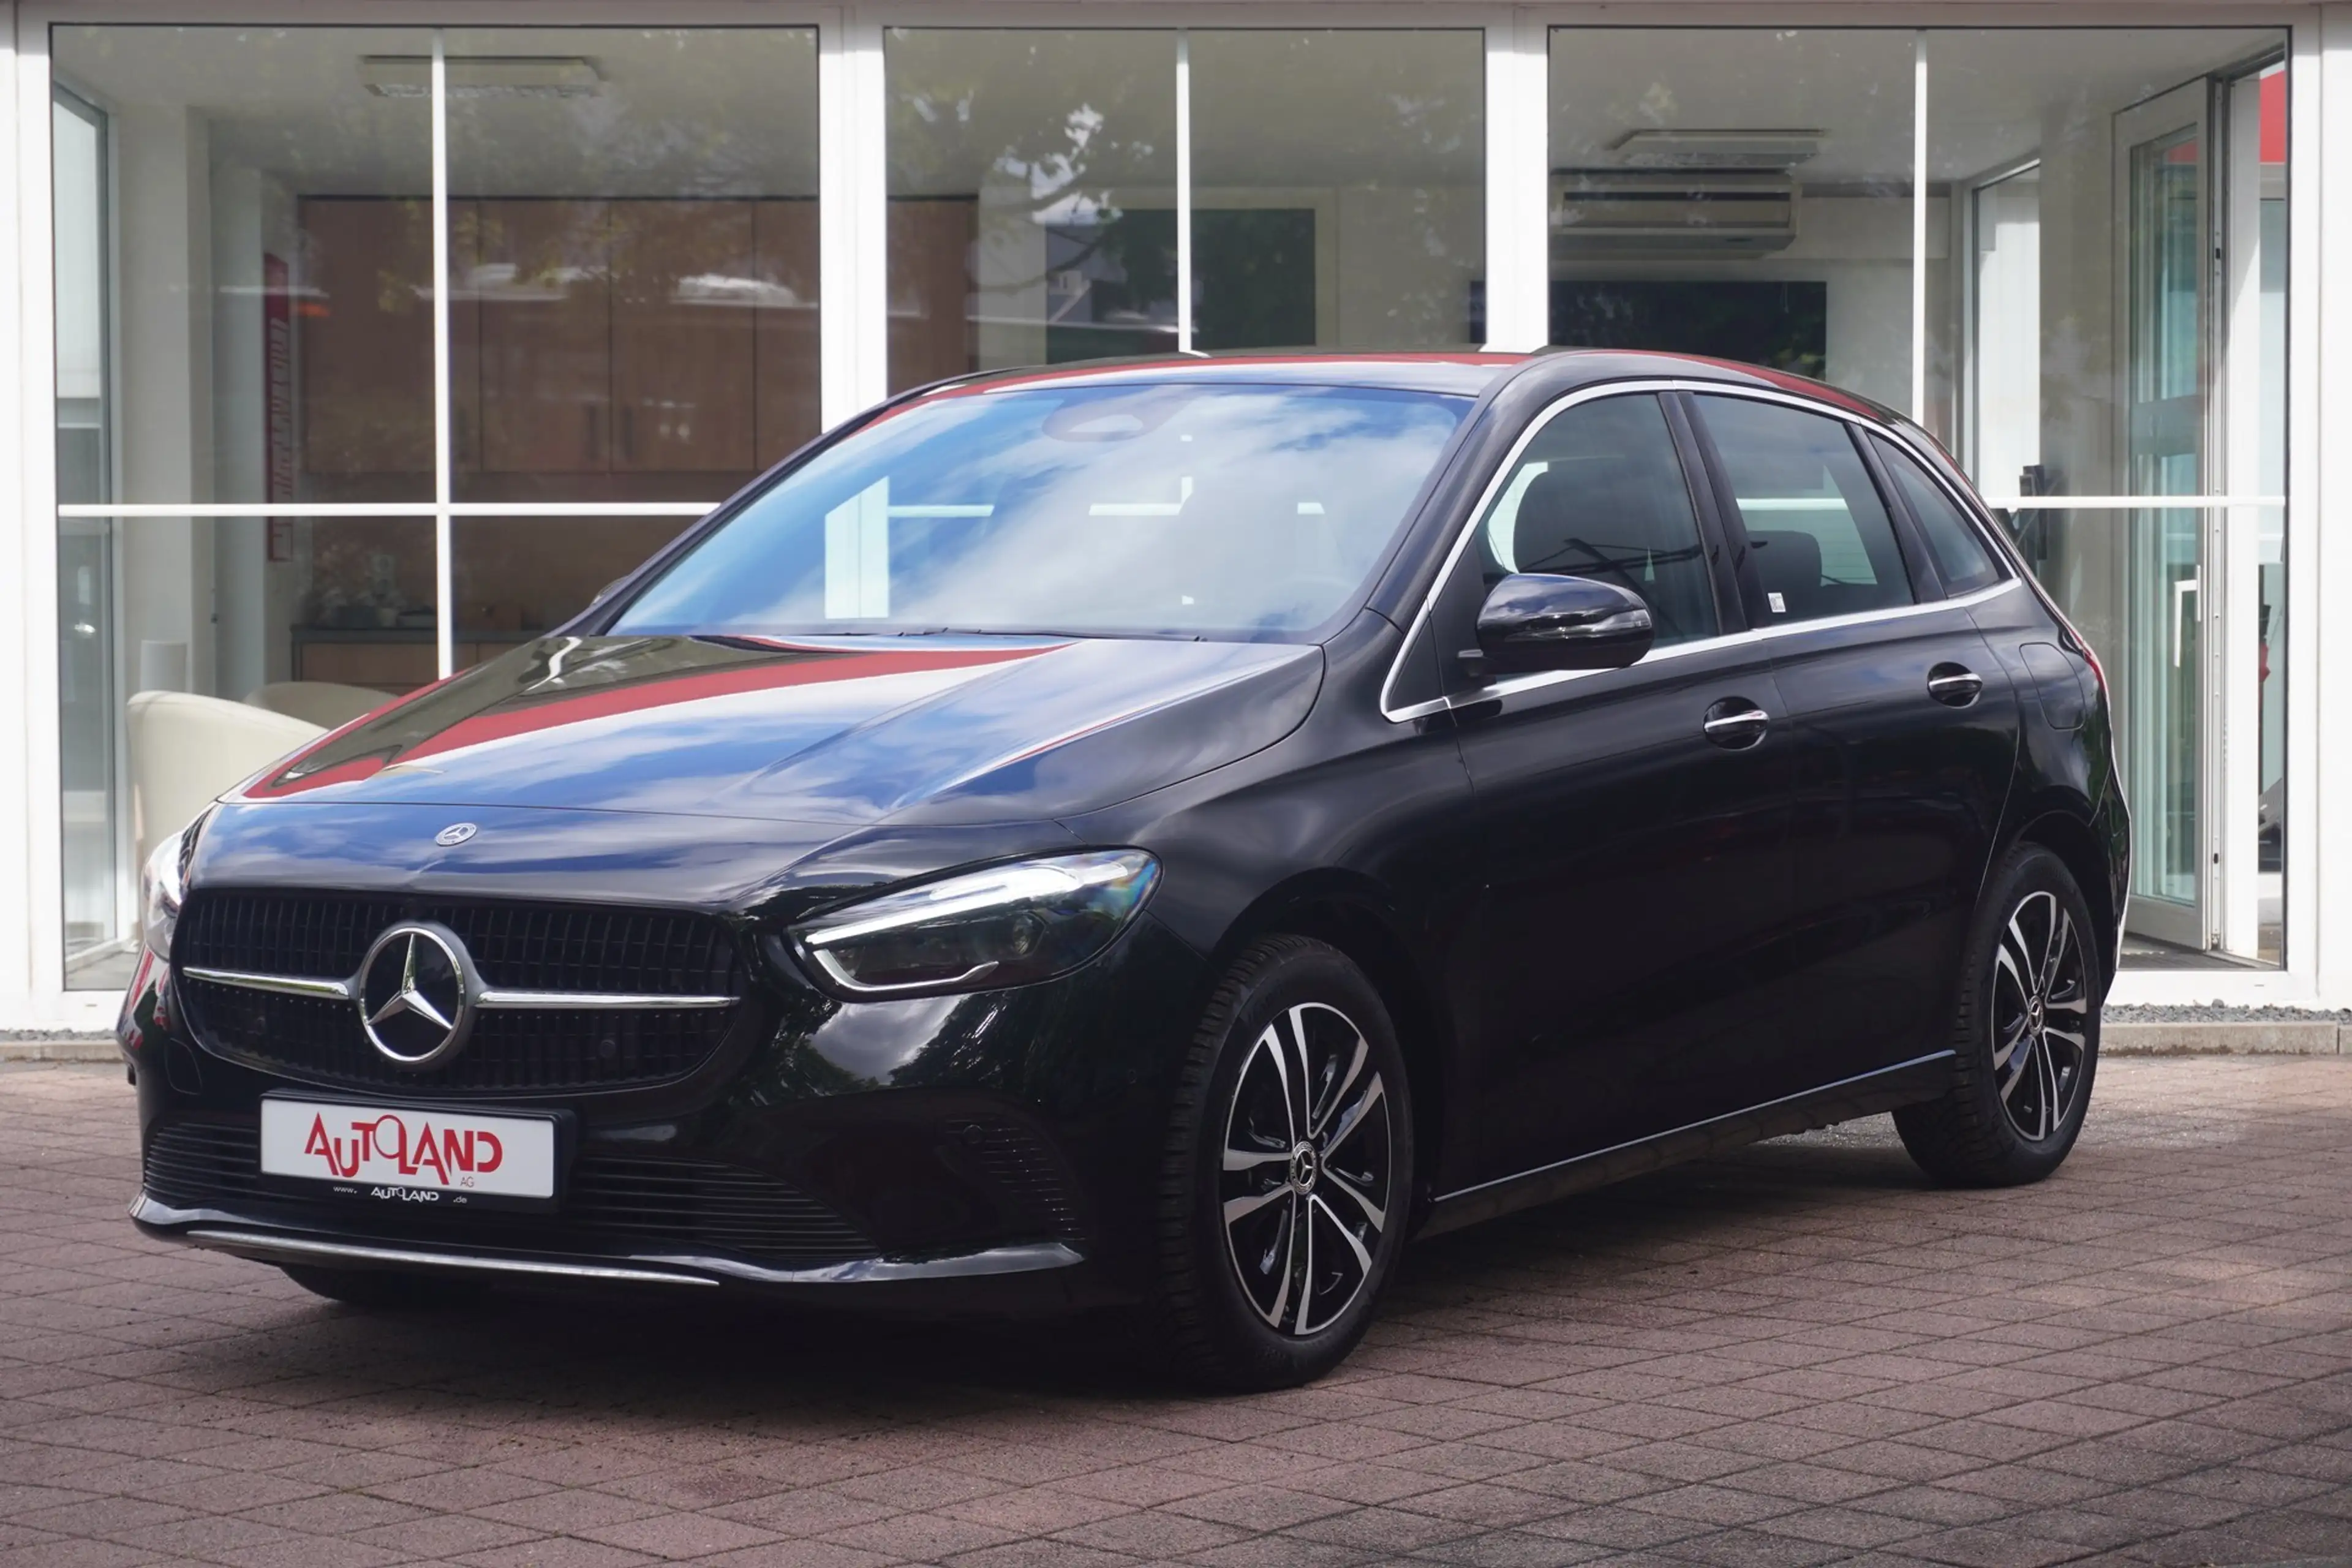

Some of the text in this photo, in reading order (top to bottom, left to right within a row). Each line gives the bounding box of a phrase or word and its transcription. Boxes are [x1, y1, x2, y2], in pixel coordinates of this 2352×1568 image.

[304, 1112, 503, 1186] AUTOLAND
[460, 1176, 475, 1188] AG
[333, 1186, 358, 1194] www.
[371, 1186, 440, 1203] AUTOLAND
